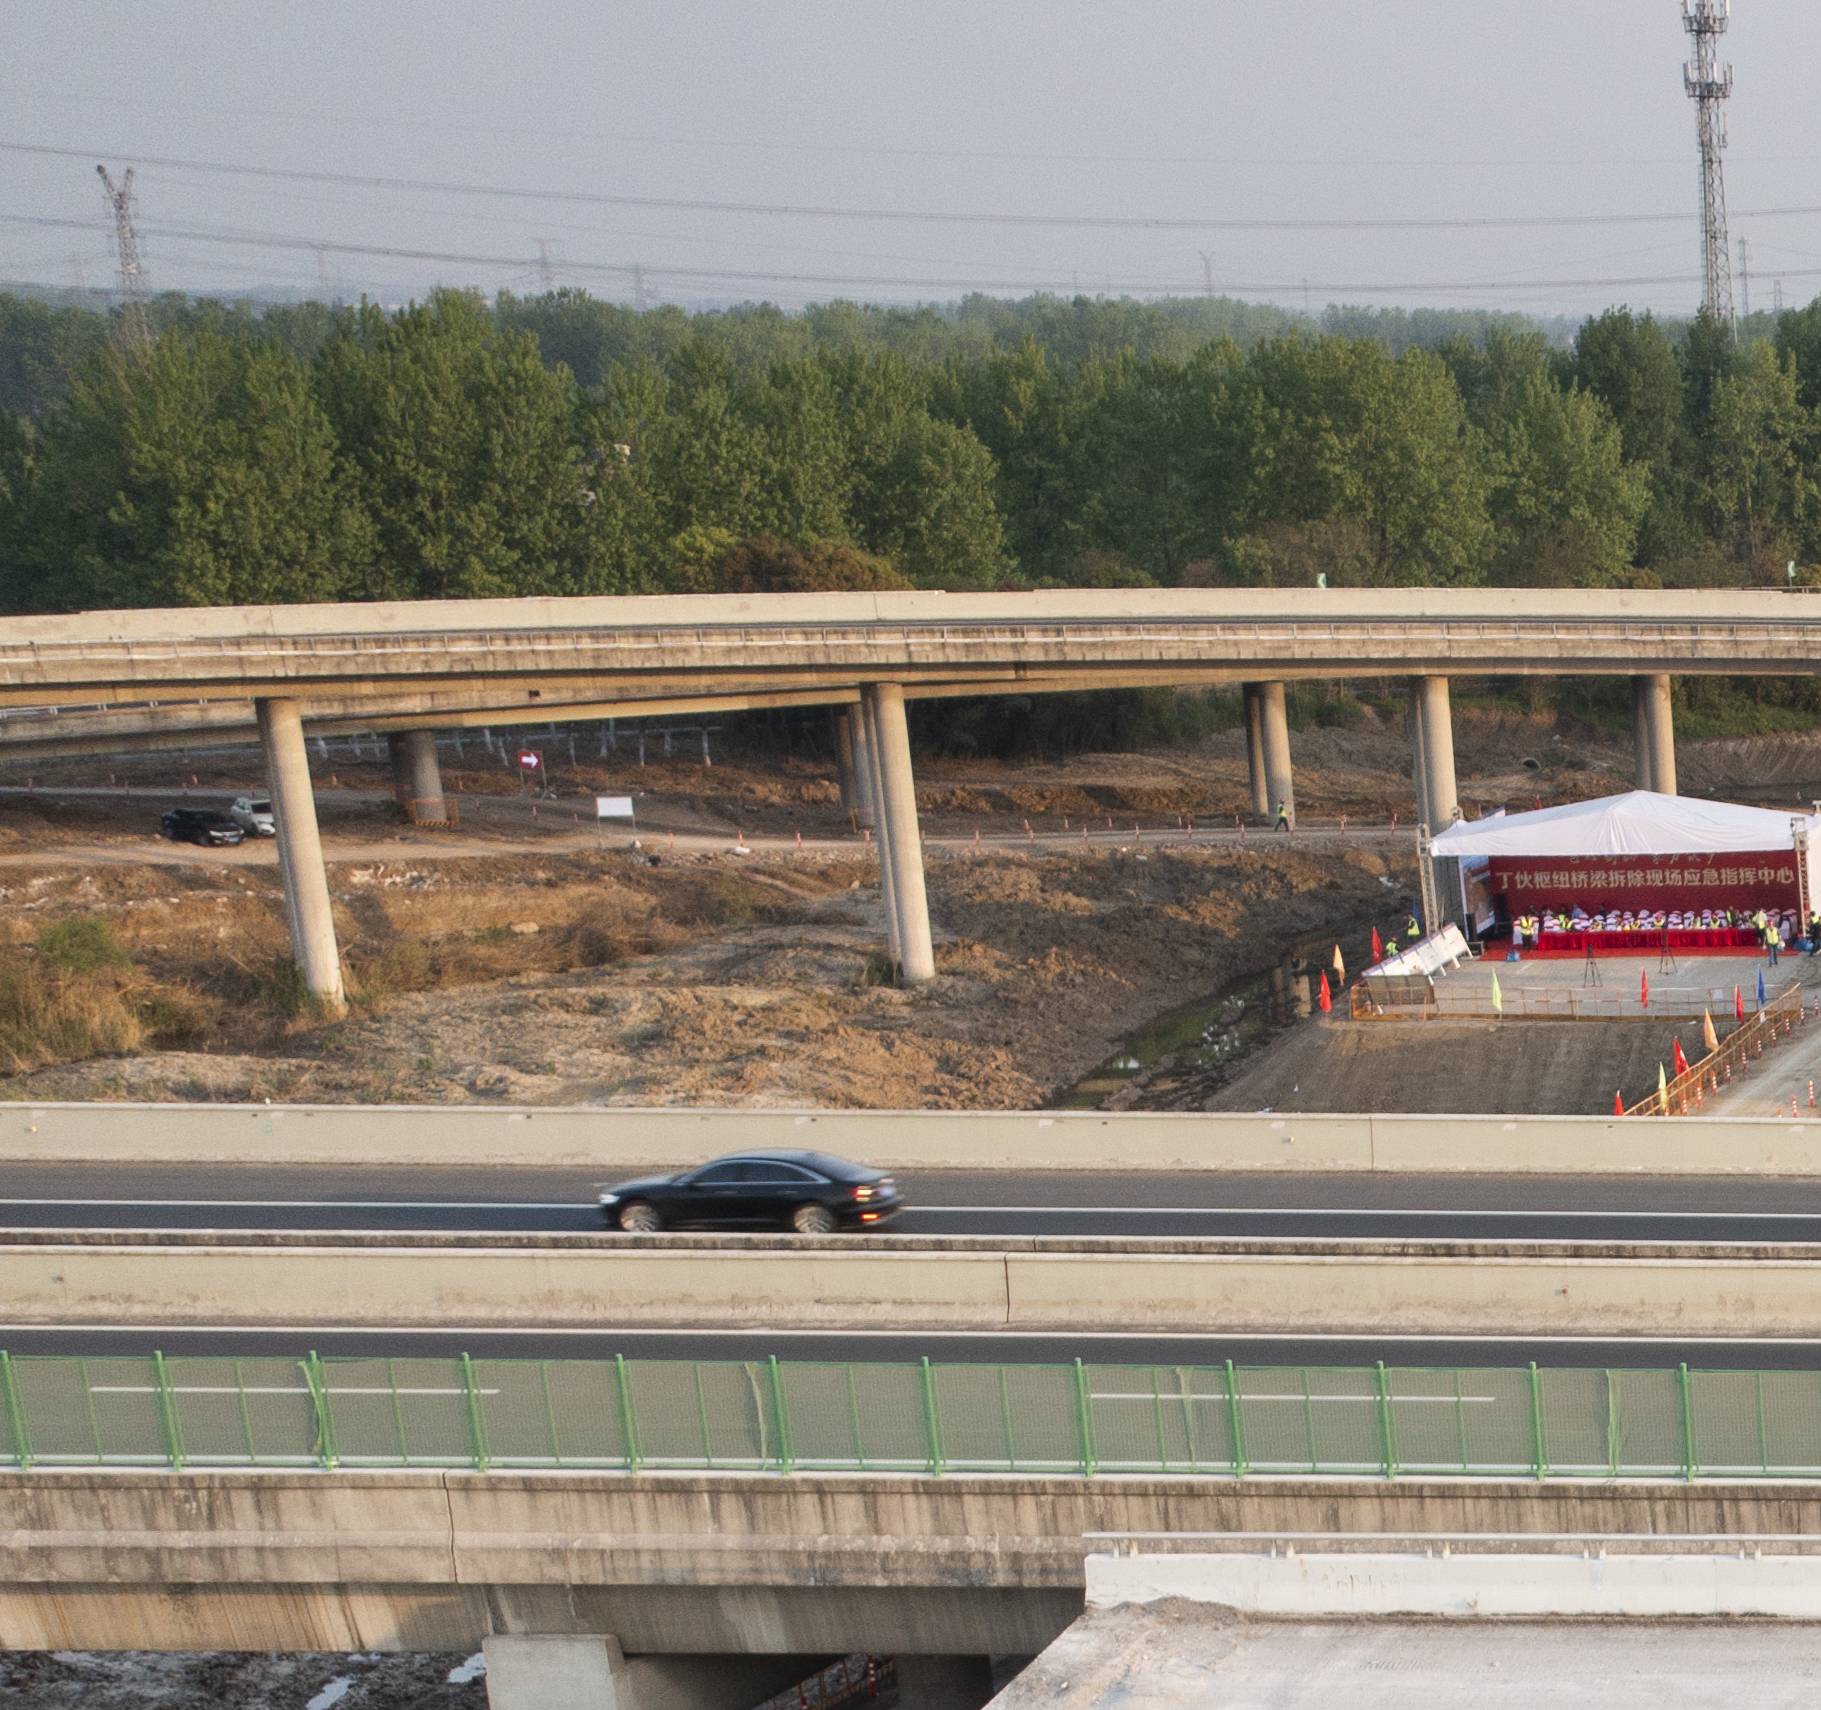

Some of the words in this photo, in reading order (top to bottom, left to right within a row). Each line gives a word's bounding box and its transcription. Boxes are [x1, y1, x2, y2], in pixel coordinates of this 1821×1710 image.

[1495, 866, 1795, 890] 丁伙枢纽桥梁拆除现场应急指挥中心
